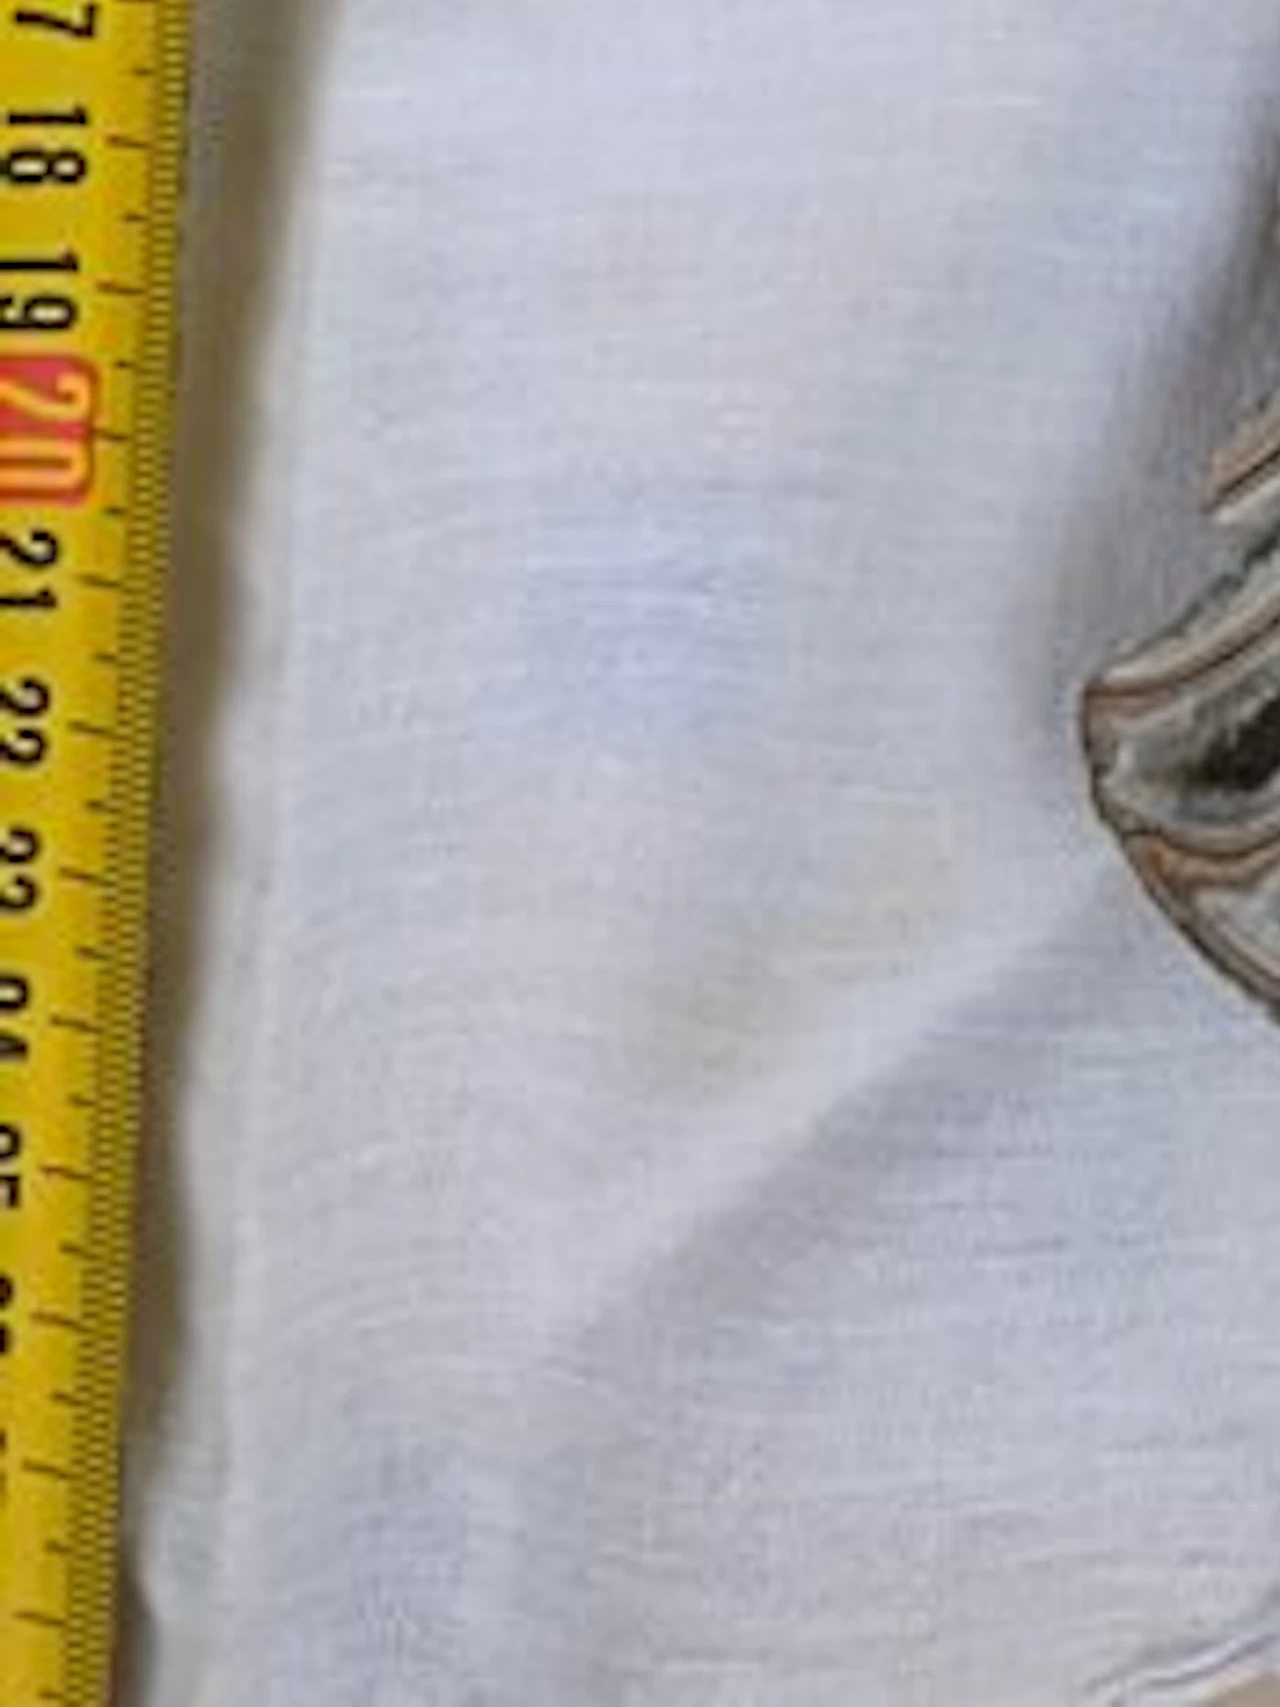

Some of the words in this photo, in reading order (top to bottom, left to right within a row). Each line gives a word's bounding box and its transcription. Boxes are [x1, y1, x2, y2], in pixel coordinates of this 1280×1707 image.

[0, 107, 90, 186] 18
[0, 251, 80, 332] 19
[0, 371, 93, 486] 20
